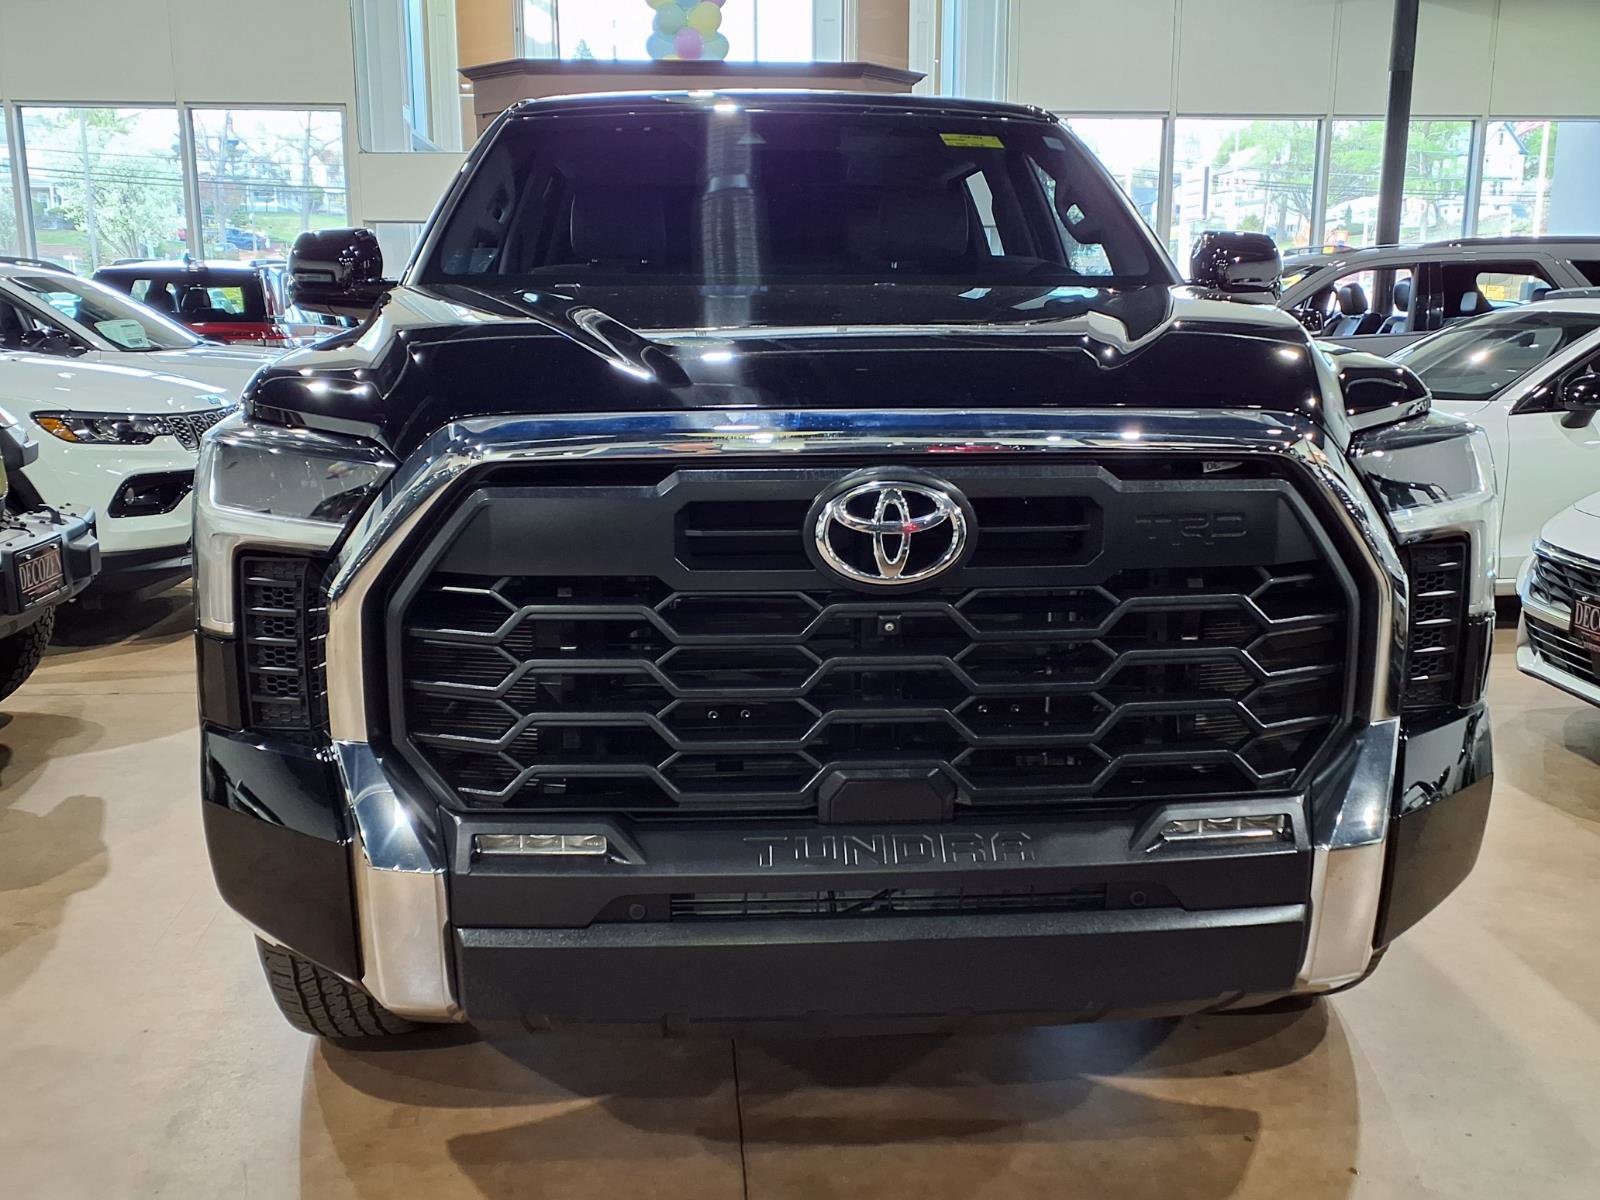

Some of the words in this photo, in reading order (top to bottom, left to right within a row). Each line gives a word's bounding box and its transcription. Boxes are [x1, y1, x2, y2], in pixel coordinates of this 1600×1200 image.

[1135, 514, 1248, 546] TRD
[18, 553, 62, 590] DECOZEN
[1575, 602, 1600, 632] DEC
[743, 832, 1036, 867] TUNDRA
